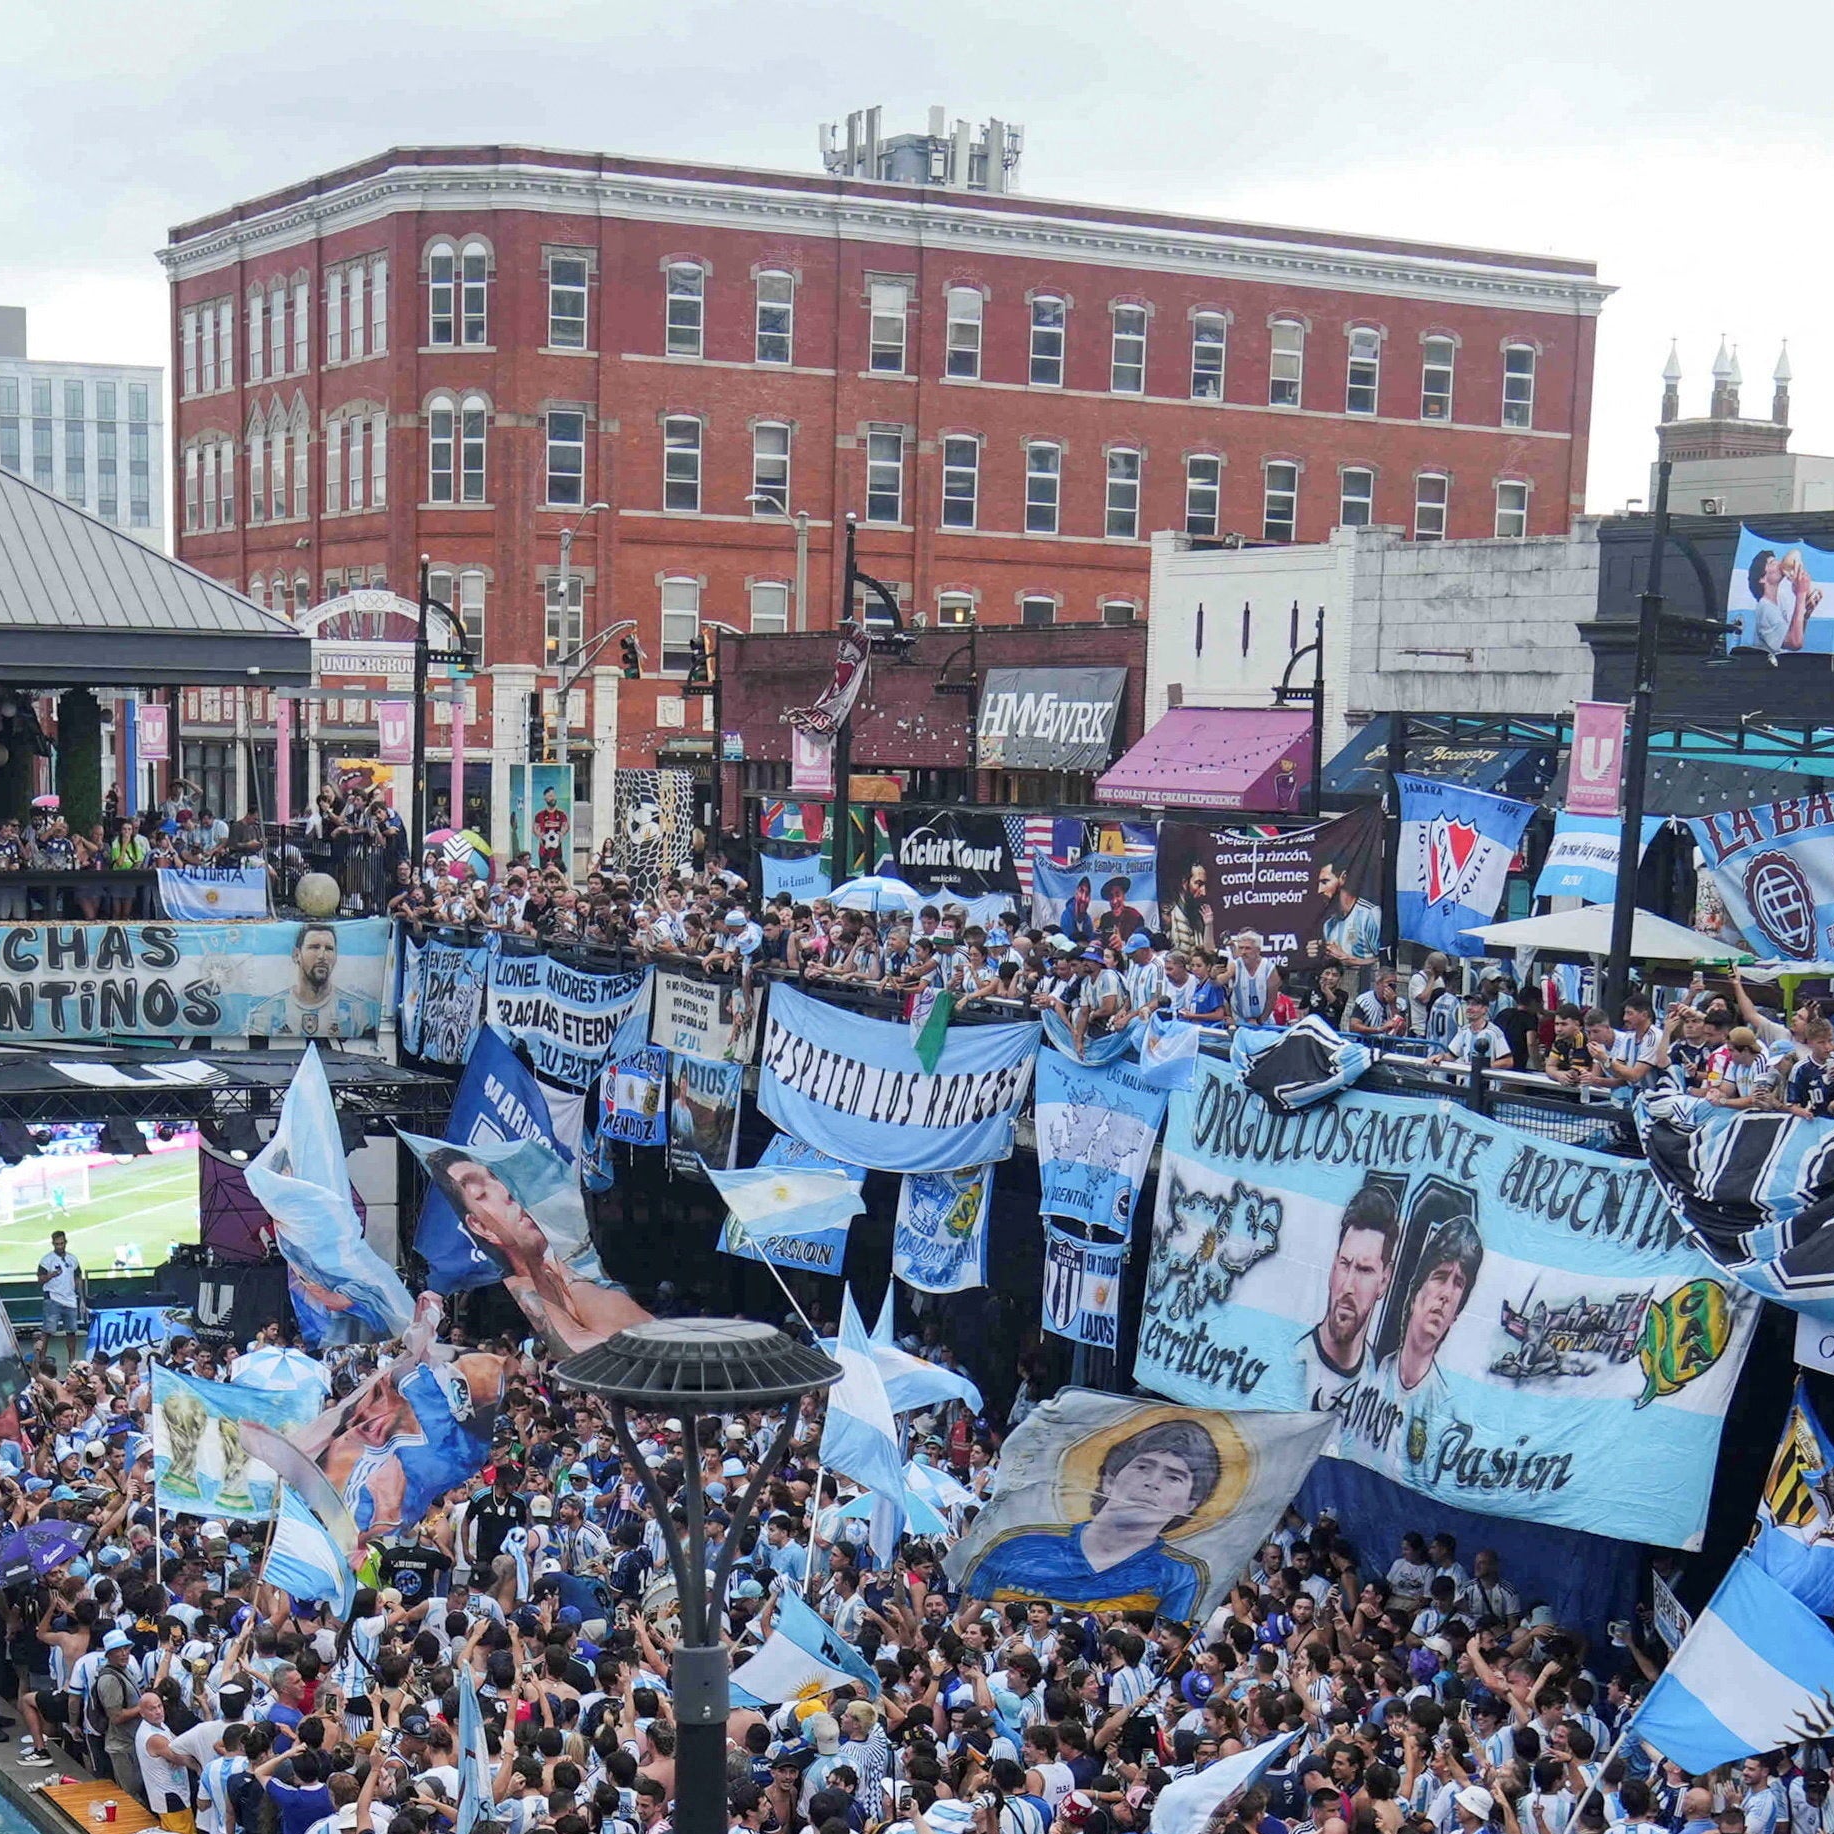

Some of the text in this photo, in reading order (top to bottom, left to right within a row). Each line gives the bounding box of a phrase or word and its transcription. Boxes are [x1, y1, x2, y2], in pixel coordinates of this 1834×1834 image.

[1112, 789, 1147, 802] COOLEST
[1147, 791, 1161, 803] ICE
[1162, 792, 1192, 804] CREAM
[1193, 793, 1241, 807] EXPERIENCE
[1403, 783, 1444, 798] SAMARA
[1700, 806, 1766, 863] LA
[1215, 851, 1231, 864] en
[1262, 848, 1312, 867] rincón,
[1220, 868, 1309, 888] como Güemes
[495, 961, 541, 988] LIONEL
[764, 1018, 866, 1116] RESPETEN
[868, 1069, 918, 1128] LOS
[1106, 1068, 1121, 1084] LAS
[1079, 1314, 1115, 1346] LADOS
